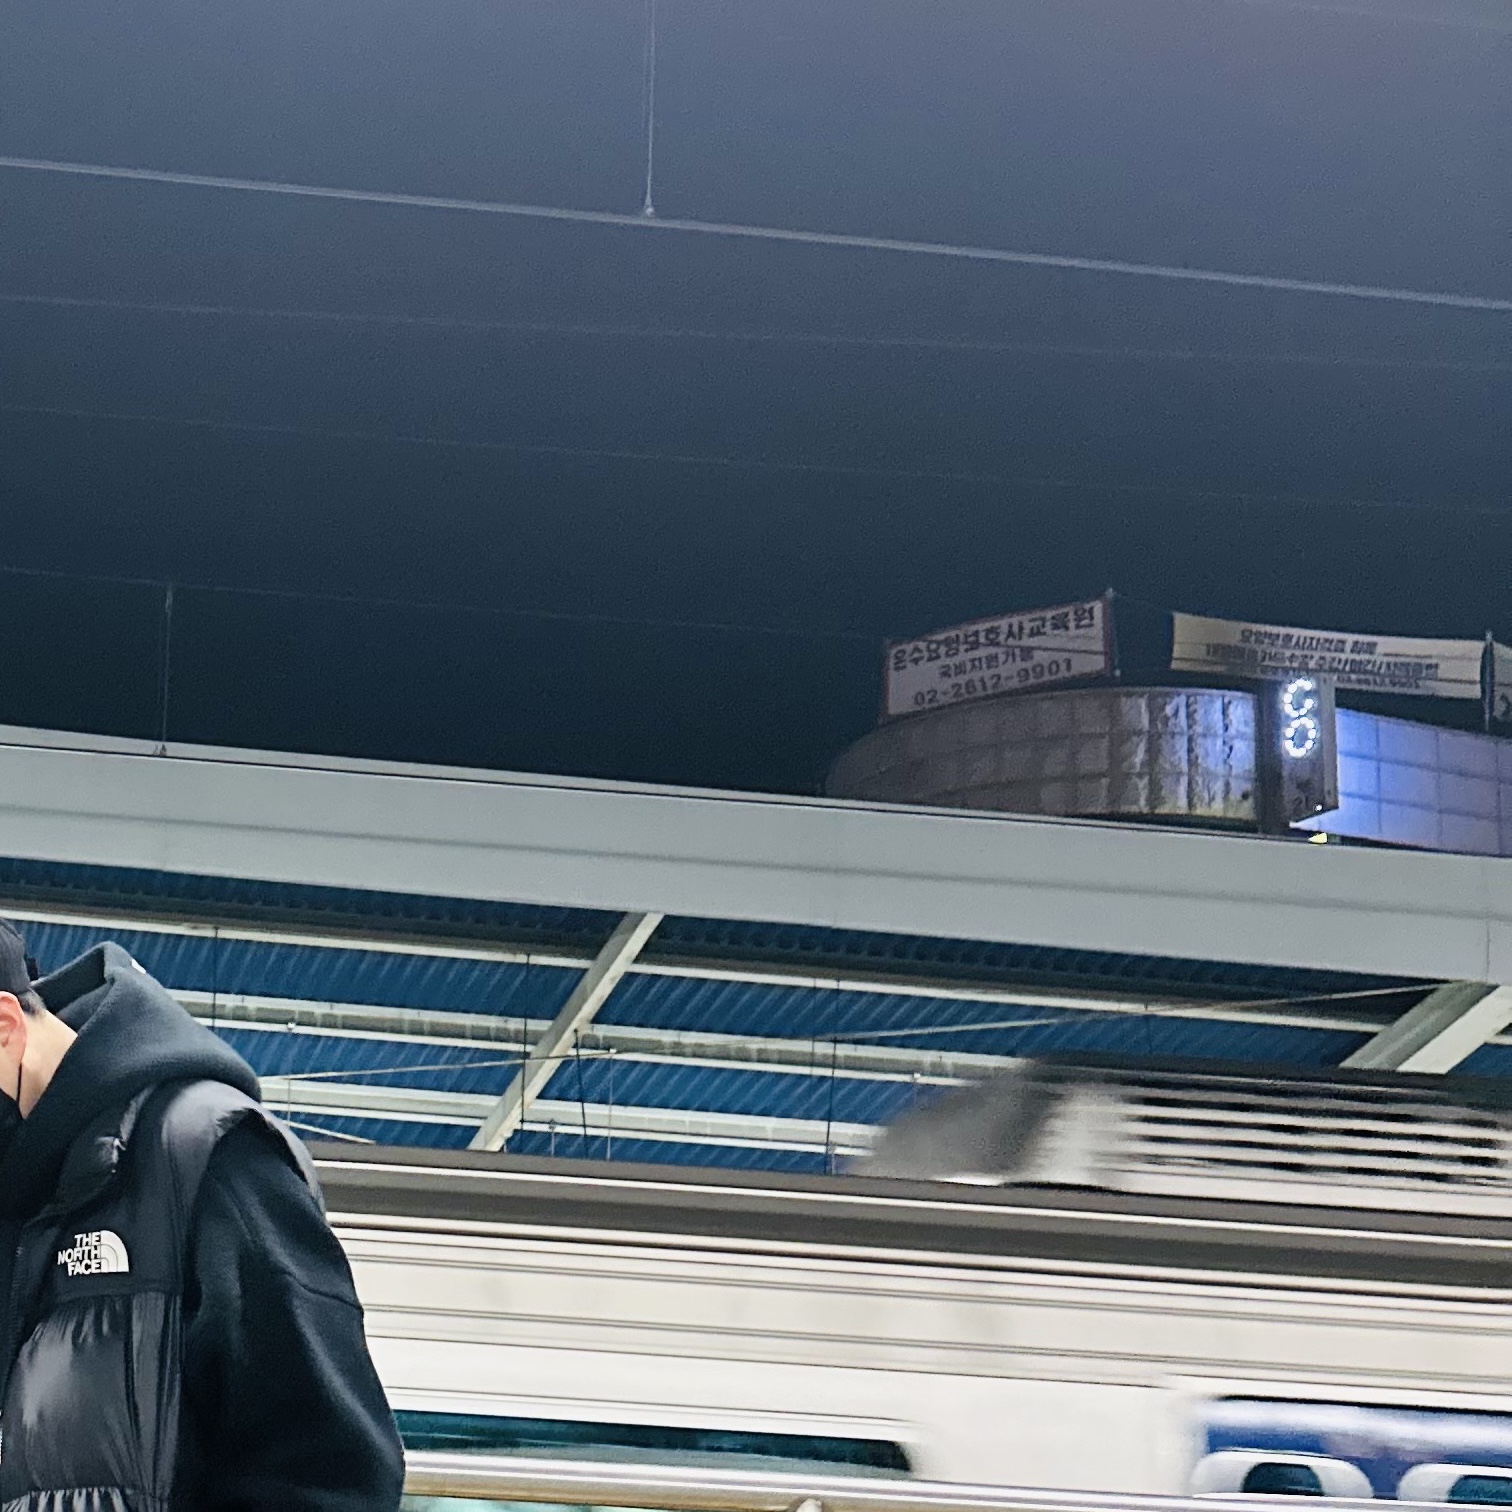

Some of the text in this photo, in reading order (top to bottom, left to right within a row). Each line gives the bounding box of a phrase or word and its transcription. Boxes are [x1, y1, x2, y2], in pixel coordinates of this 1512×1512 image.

[914, 658, 1072, 706] 02-2612-9901
[74, 1231, 101, 1248] THE
[57, 1245, 101, 1265] NORTH
[67, 1259, 101, 1276] FACE
